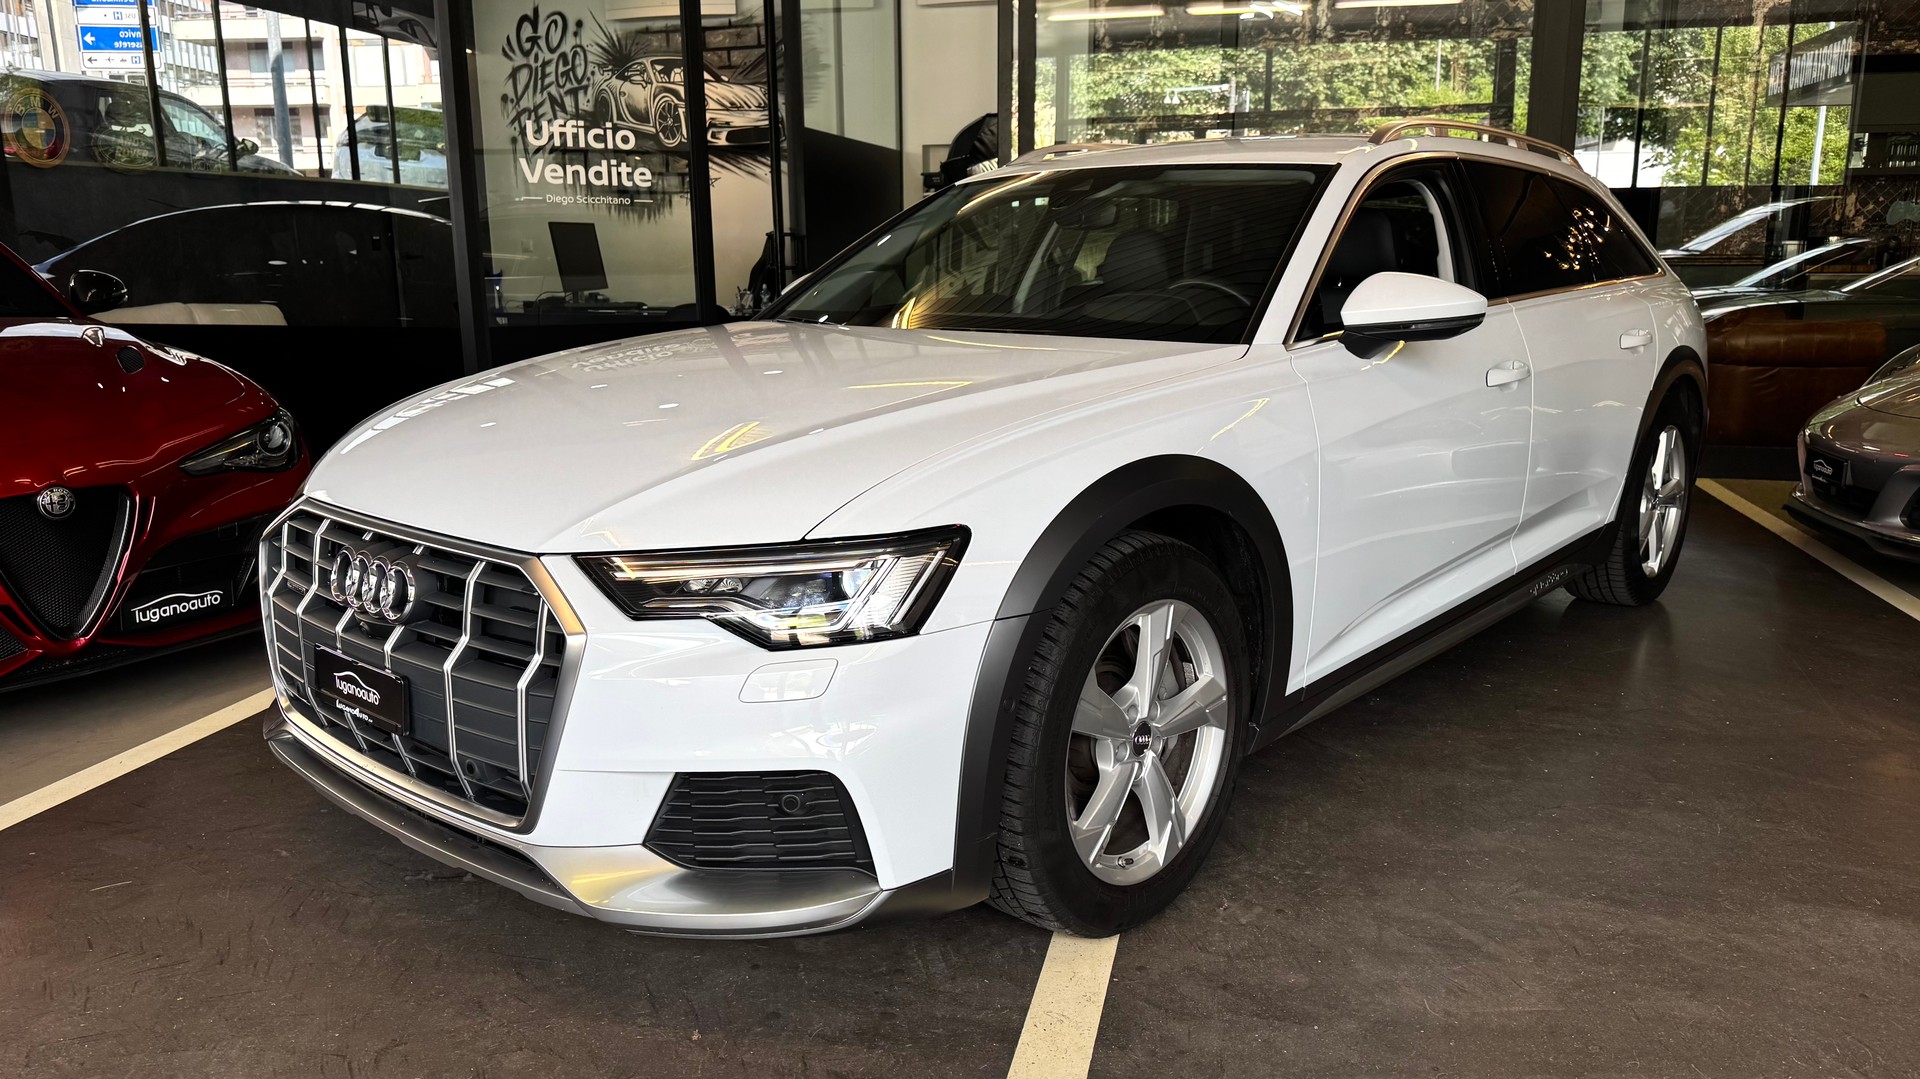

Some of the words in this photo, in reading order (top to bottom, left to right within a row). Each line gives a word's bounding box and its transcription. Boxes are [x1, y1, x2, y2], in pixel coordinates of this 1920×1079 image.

[516, 5, 568, 58] GO
[506, 45, 589, 108] DIEGO
[15, 96, 59, 119] BMW
[526, 119, 636, 150] Ufficio
[519, 158, 652, 188] Vendite
[546, 194, 574, 206] Diego
[576, 195, 631, 205] Scicchitano
[135, 594, 221, 623] luganoauto
[335, 675, 380, 706] luganoauto
